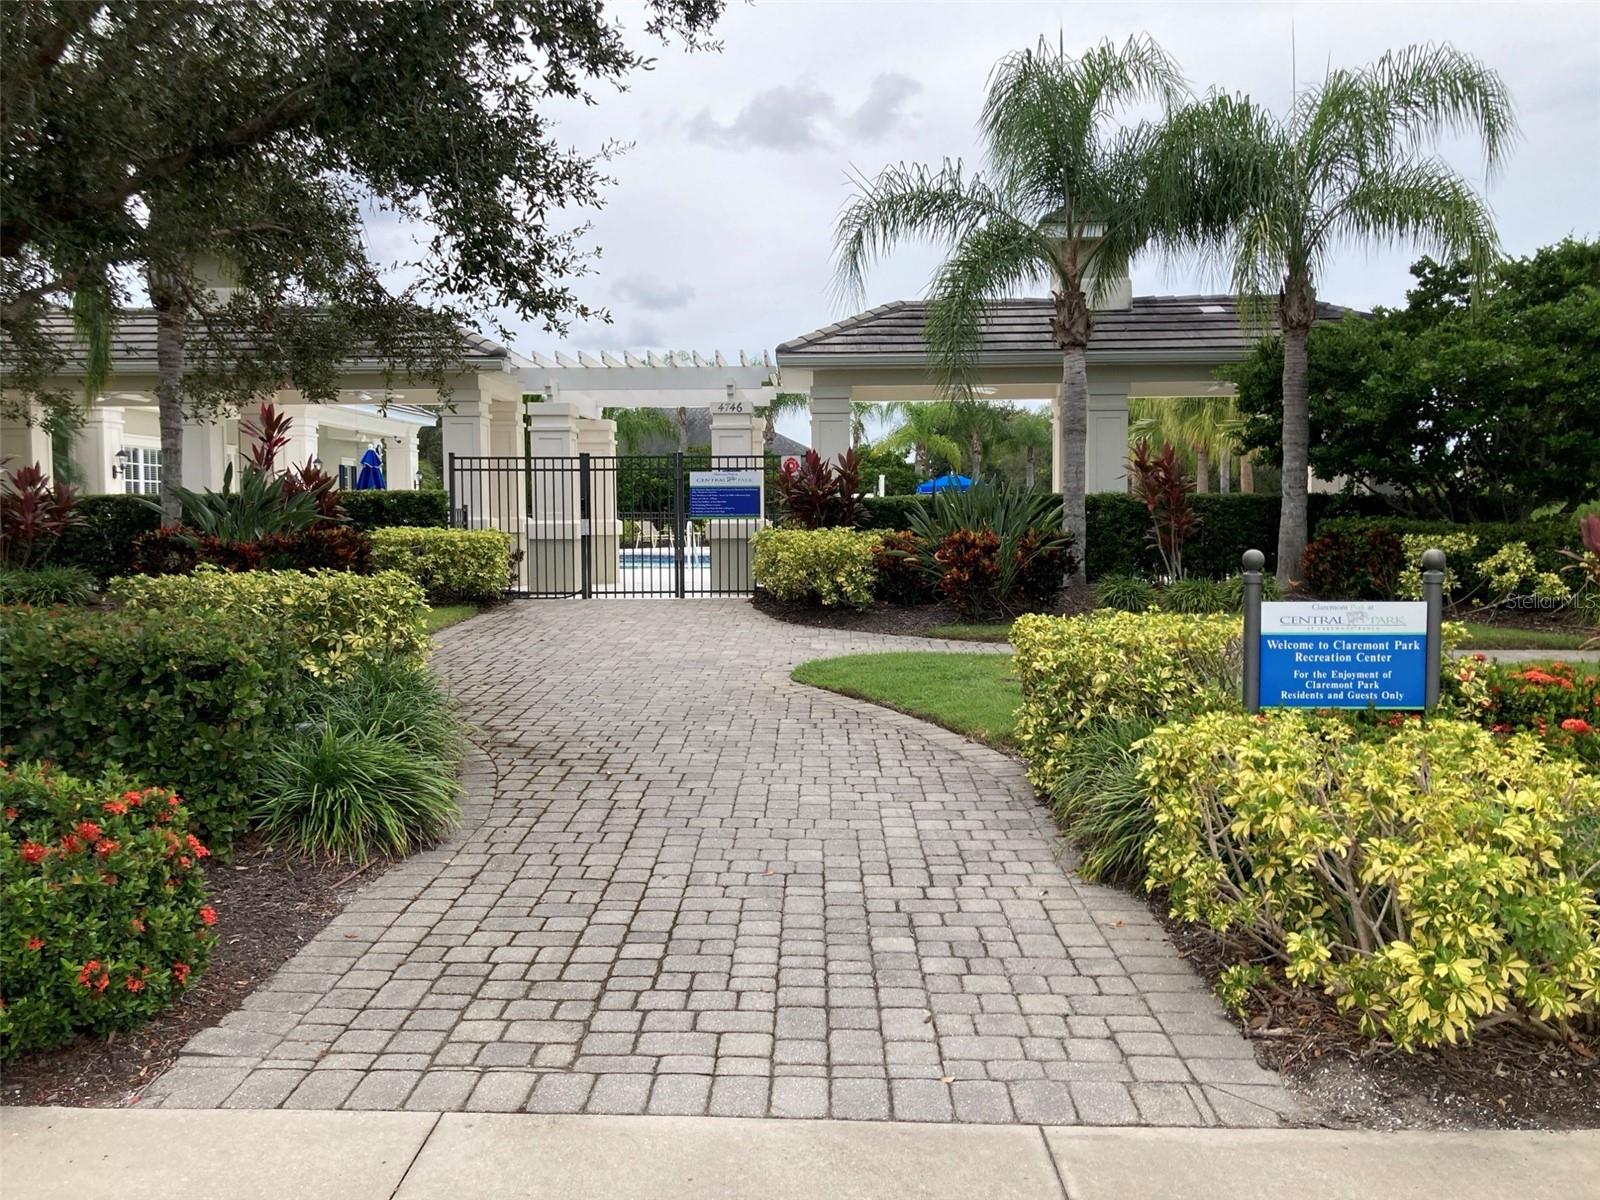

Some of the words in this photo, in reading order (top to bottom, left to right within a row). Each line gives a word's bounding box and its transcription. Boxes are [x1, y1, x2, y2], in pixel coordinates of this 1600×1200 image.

[718, 402, 743, 413] 4746
[1279, 615, 1344, 625] CENTRAL
[1370, 615, 1406, 625] PARK
[1267, 640, 1314, 650] Welcome
[1318, 640, 1329, 650] to
[1333, 639, 1389, 650] Claremont
[1394, 640, 1420, 650] Park
[1295, 652, 1352, 662] Recreation
[1356, 652, 1392, 662] Center
[1293, 670, 1309, 679] For
[1313, 670, 1327, 679] the
[1331, 670, 1378, 680] Enjoyment
[1382, 670, 1392, 679] of
[1305, 680, 1353, 689] Claremont
[1357, 680, 1379, 689] Park
[1280, 690, 1324, 700] Residents
[1327, 690, 1344, 700] and
[1347, 690, 1378, 700] Guests
[1381, 690, 1404, 701] Only
